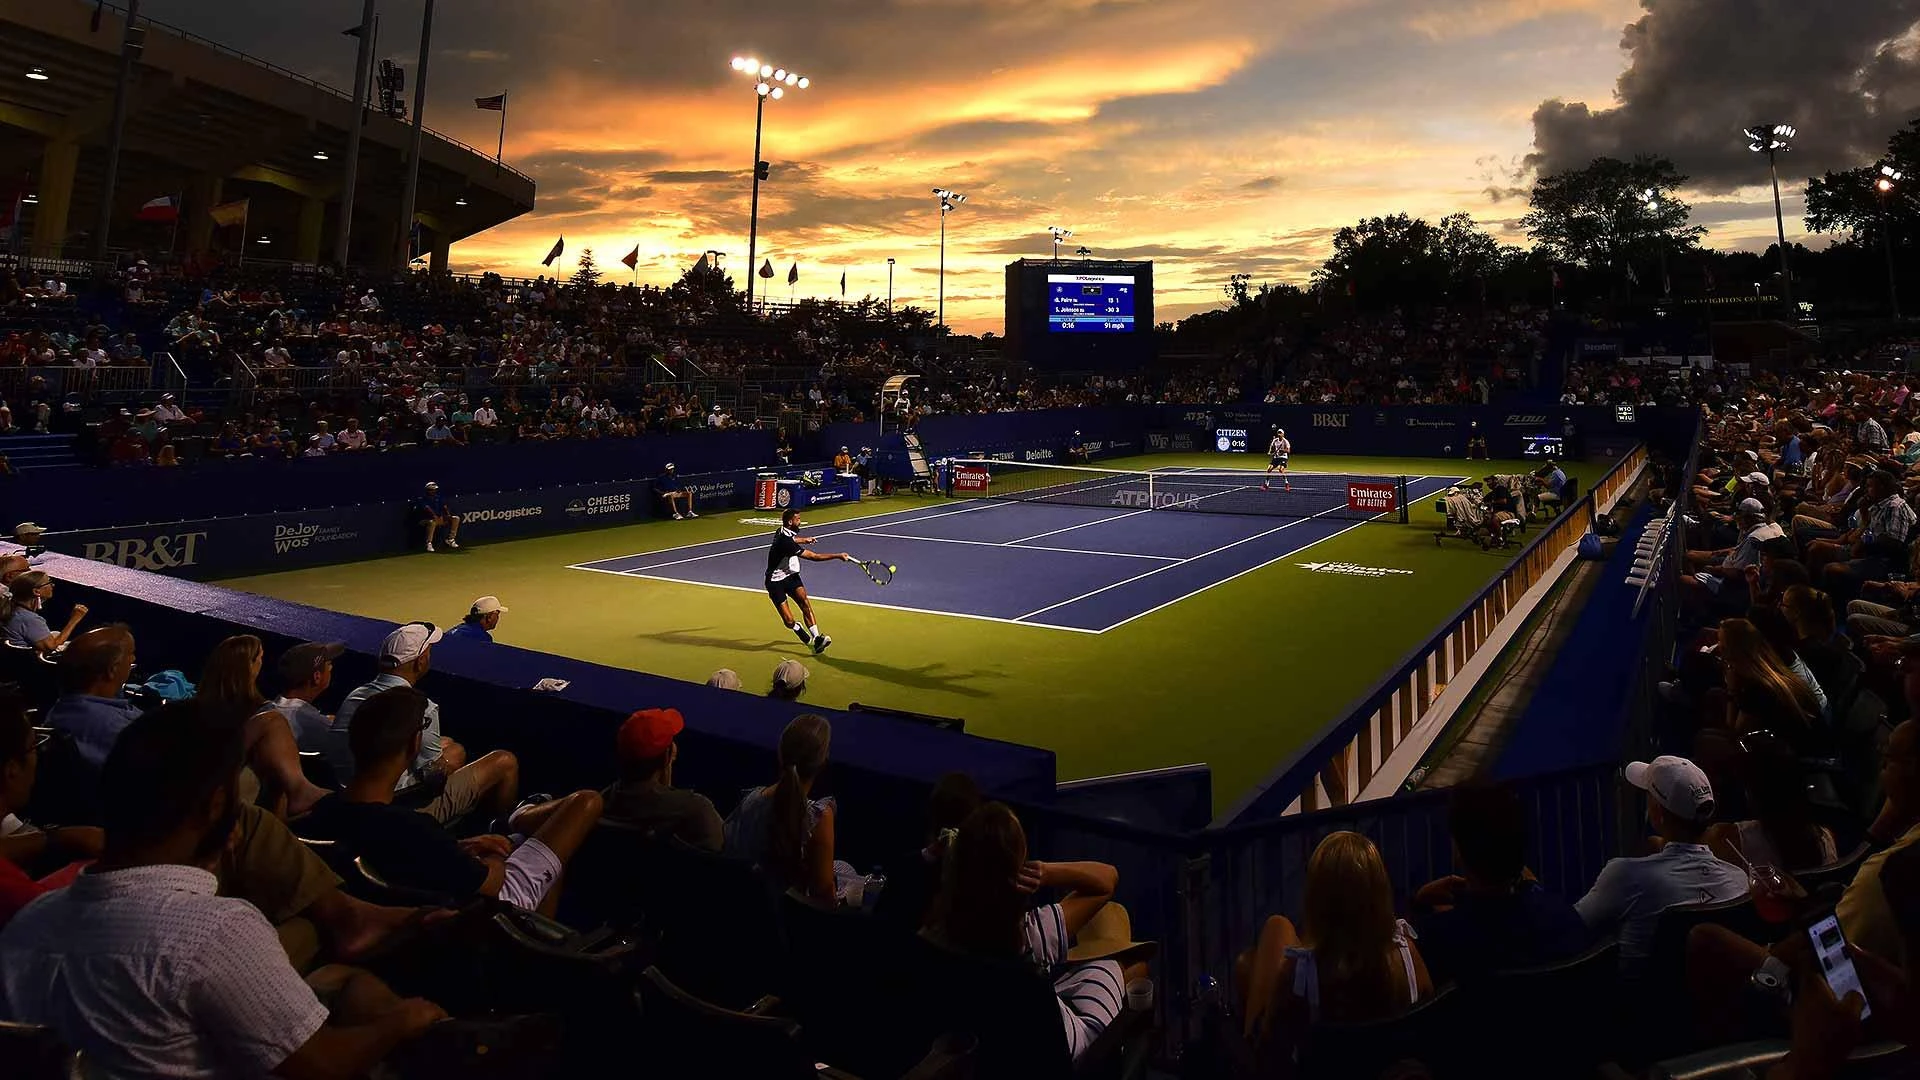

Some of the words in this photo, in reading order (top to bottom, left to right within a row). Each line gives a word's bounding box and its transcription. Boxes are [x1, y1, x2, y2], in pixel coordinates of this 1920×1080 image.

[1312, 413, 1350, 427] BB&T
[1405, 418, 1456, 429] Champion
[1507, 415, 1547, 424] FLOW
[1216, 429, 1246, 437] CITIZEN
[1026, 449, 1054, 460] Deloitte.
[1543, 445, 1555, 454] 91
[956, 471, 985, 480] Emirates
[759, 481, 767, 506] Wilson
[1111, 489, 1150, 505] ATP
[1152, 491, 1200, 509] TOUR
[1350, 487, 1393, 499] Emirates
[587, 494, 631, 507] CHEESES
[462, 506, 543, 524] XPOLogistics
[587, 507, 598, 515] OF
[600, 502, 630, 513] EUROPE
[275, 523, 320, 536] DeJoy
[274, 537, 310, 554] Wos
